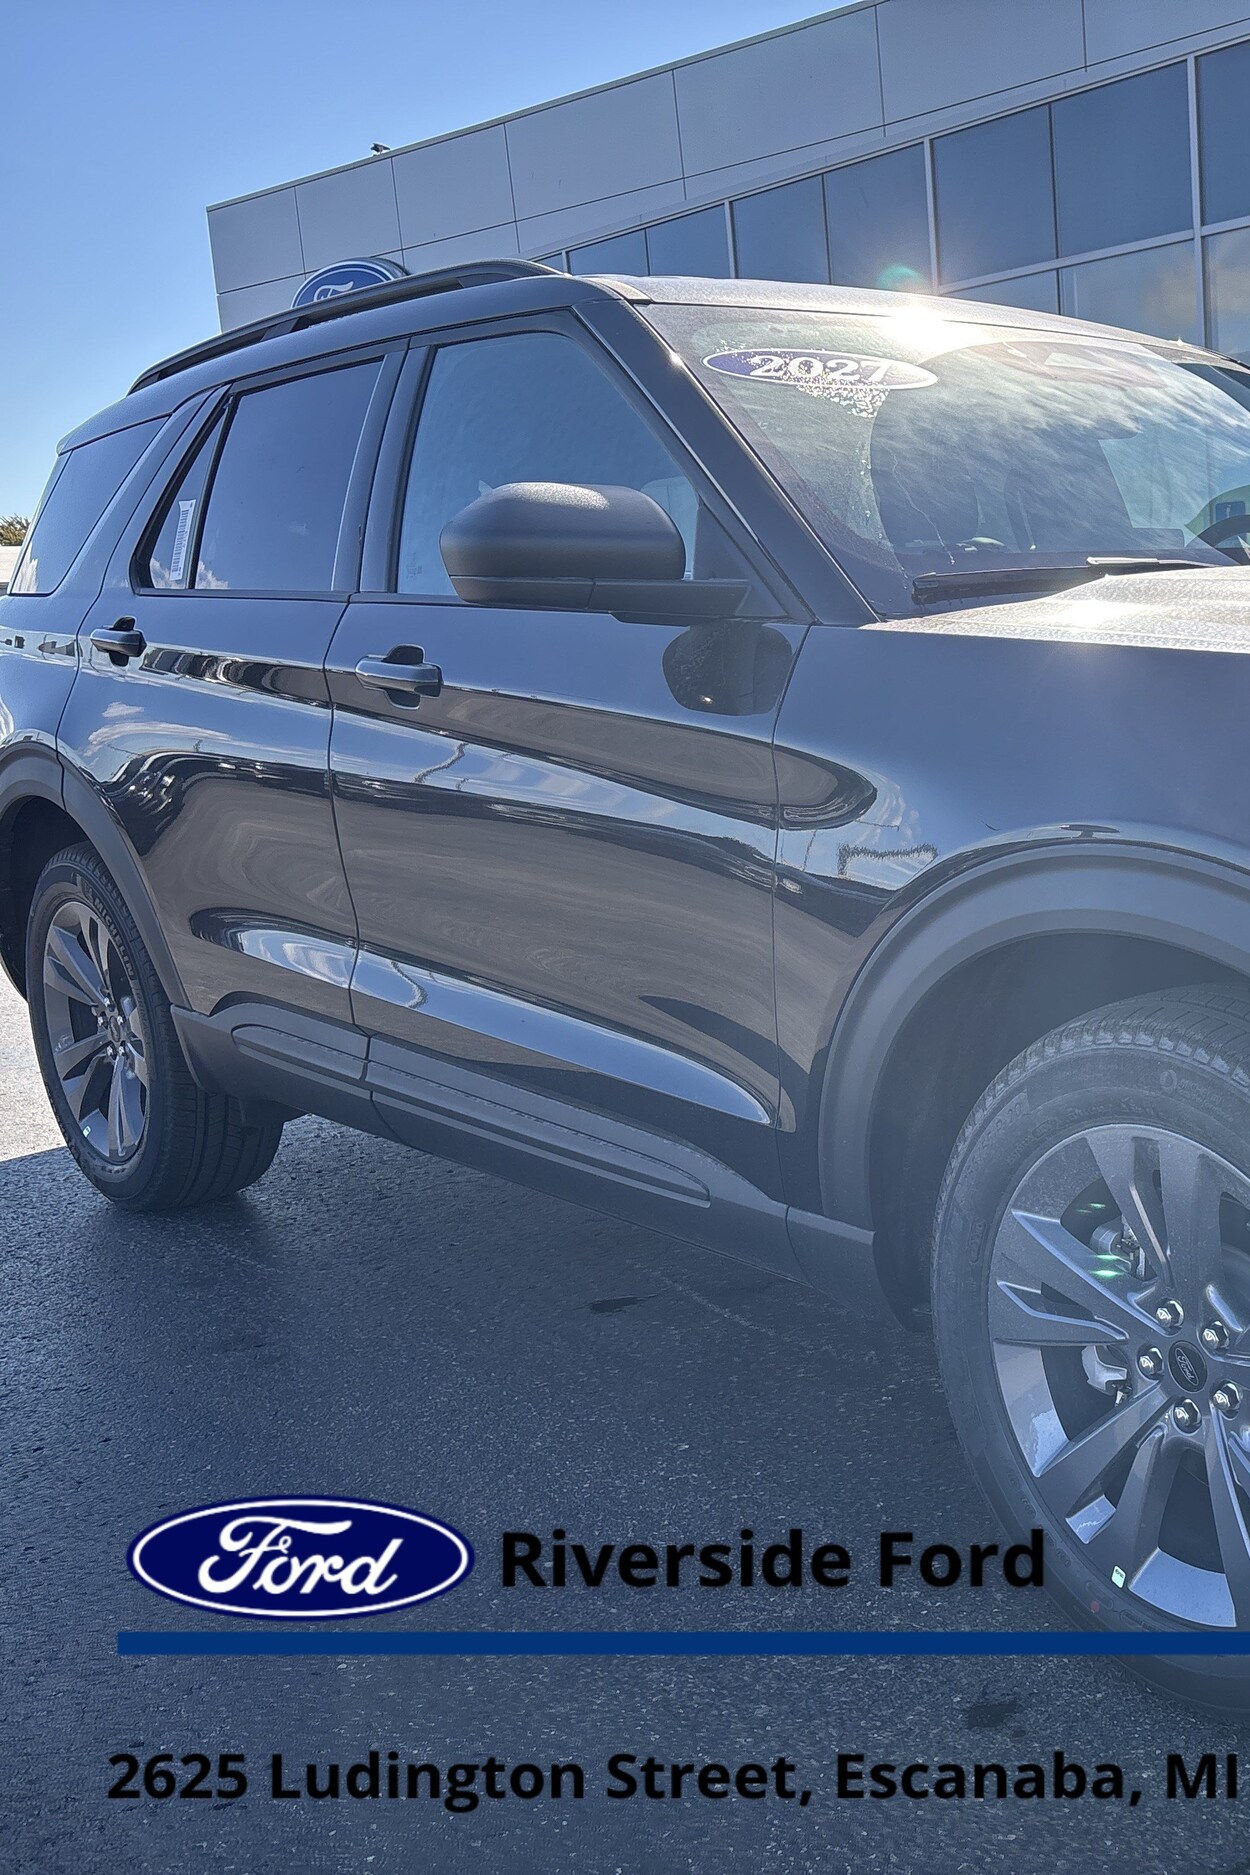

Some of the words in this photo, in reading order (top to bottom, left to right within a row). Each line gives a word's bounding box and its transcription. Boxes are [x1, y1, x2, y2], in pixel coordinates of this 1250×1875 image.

[747, 355, 890, 382] 2027
[94, 898, 135, 976] MICHELIN
[1177, 1353, 1196, 1380] Ford
